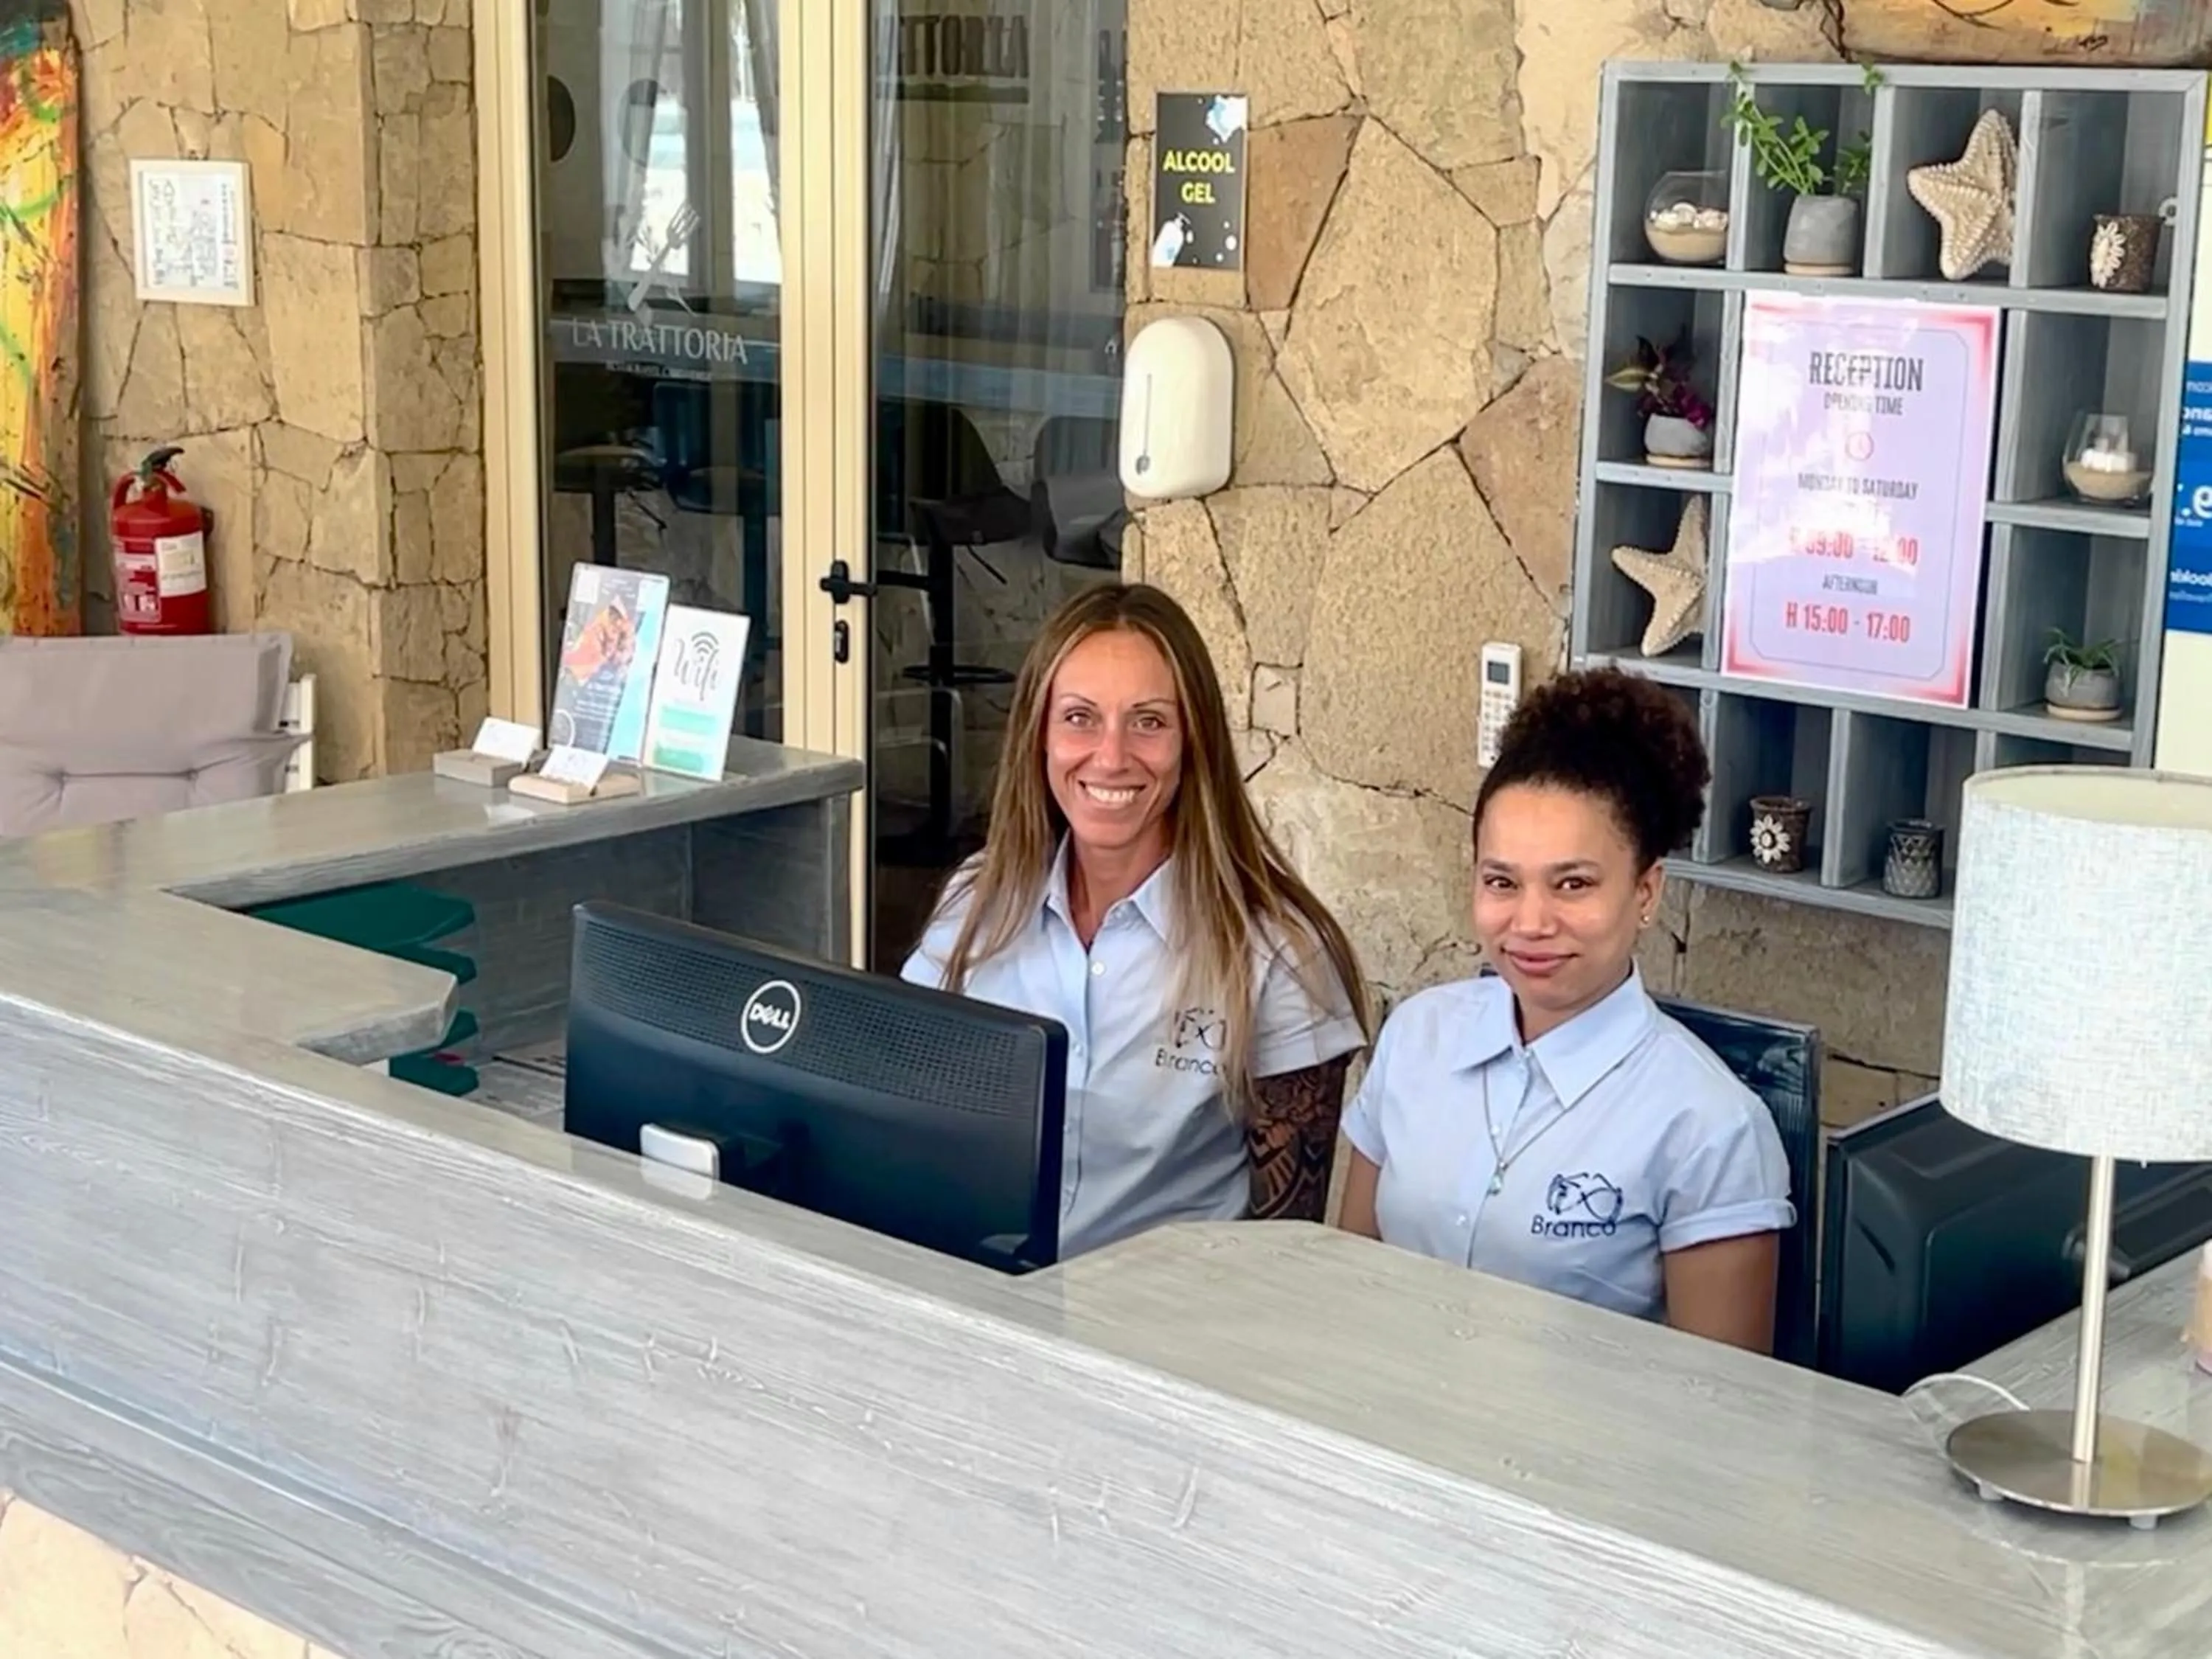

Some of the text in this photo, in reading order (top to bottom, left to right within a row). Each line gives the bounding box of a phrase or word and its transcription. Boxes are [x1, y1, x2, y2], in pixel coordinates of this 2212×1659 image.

[1162, 150, 1236, 174] ALCOOL
[1181, 181, 1216, 204] GEL
[572, 317, 748, 366] LA TRATTORIA
[1809, 351, 1924, 392] RECEPTION
[1875, 395, 1904, 416] TIME
[1863, 478, 1919, 500] SATURDAY
[1786, 601, 1798, 628] H
[1804, 604, 1848, 635] 15:00
[1867, 611, 1911, 643] 17:00
[749, 1001, 790, 1030] DELL
[1531, 1214, 1616, 1238] Branco
